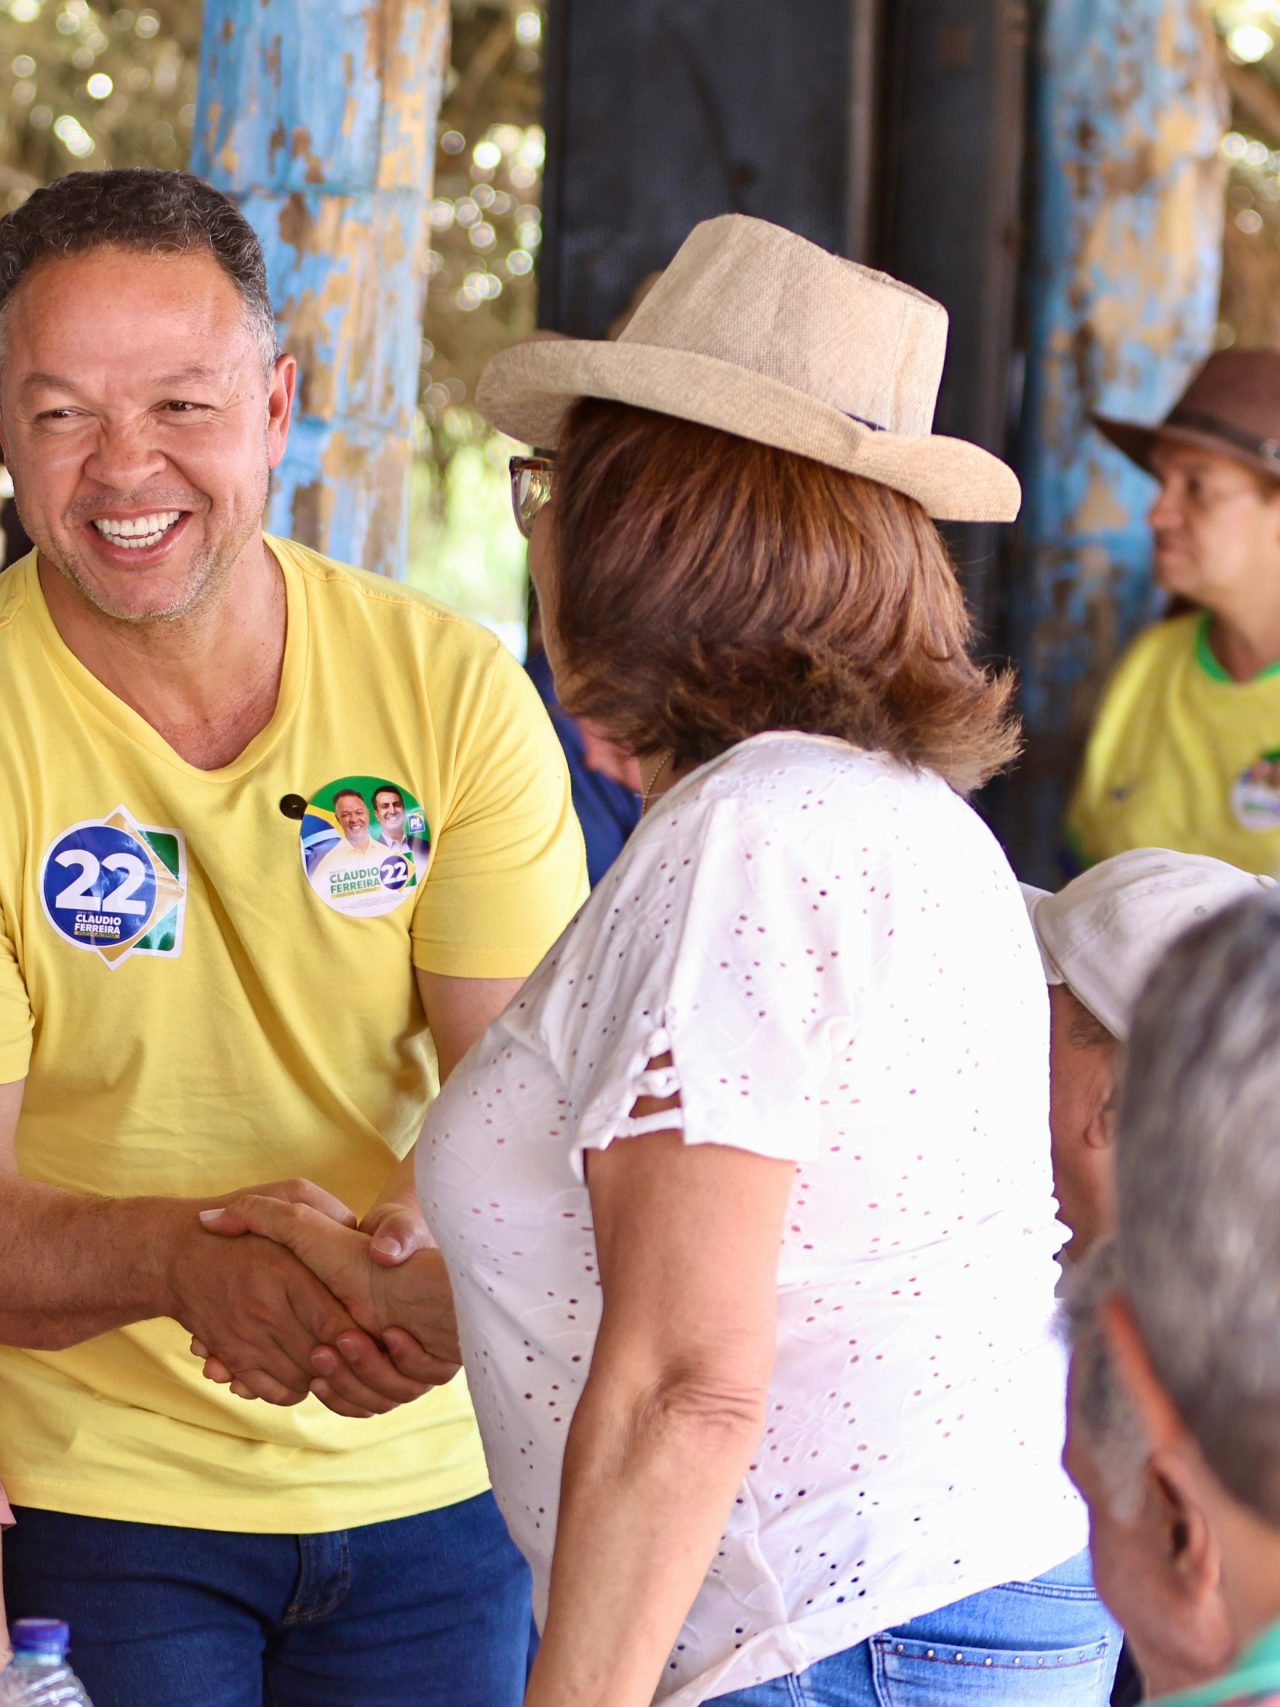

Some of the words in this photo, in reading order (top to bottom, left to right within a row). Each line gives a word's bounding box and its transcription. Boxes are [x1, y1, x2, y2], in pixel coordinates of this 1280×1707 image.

[410, 818, 422, 829] PL
[329, 866, 380, 884] CLAUDIO
[380, 861, 408, 885] 22
[54, 849, 147, 916] 22
[330, 877, 381, 893] FERREIRA
[75, 914, 121, 926] CLAUDIO
[74, 923, 121, 934] FERREIRA
